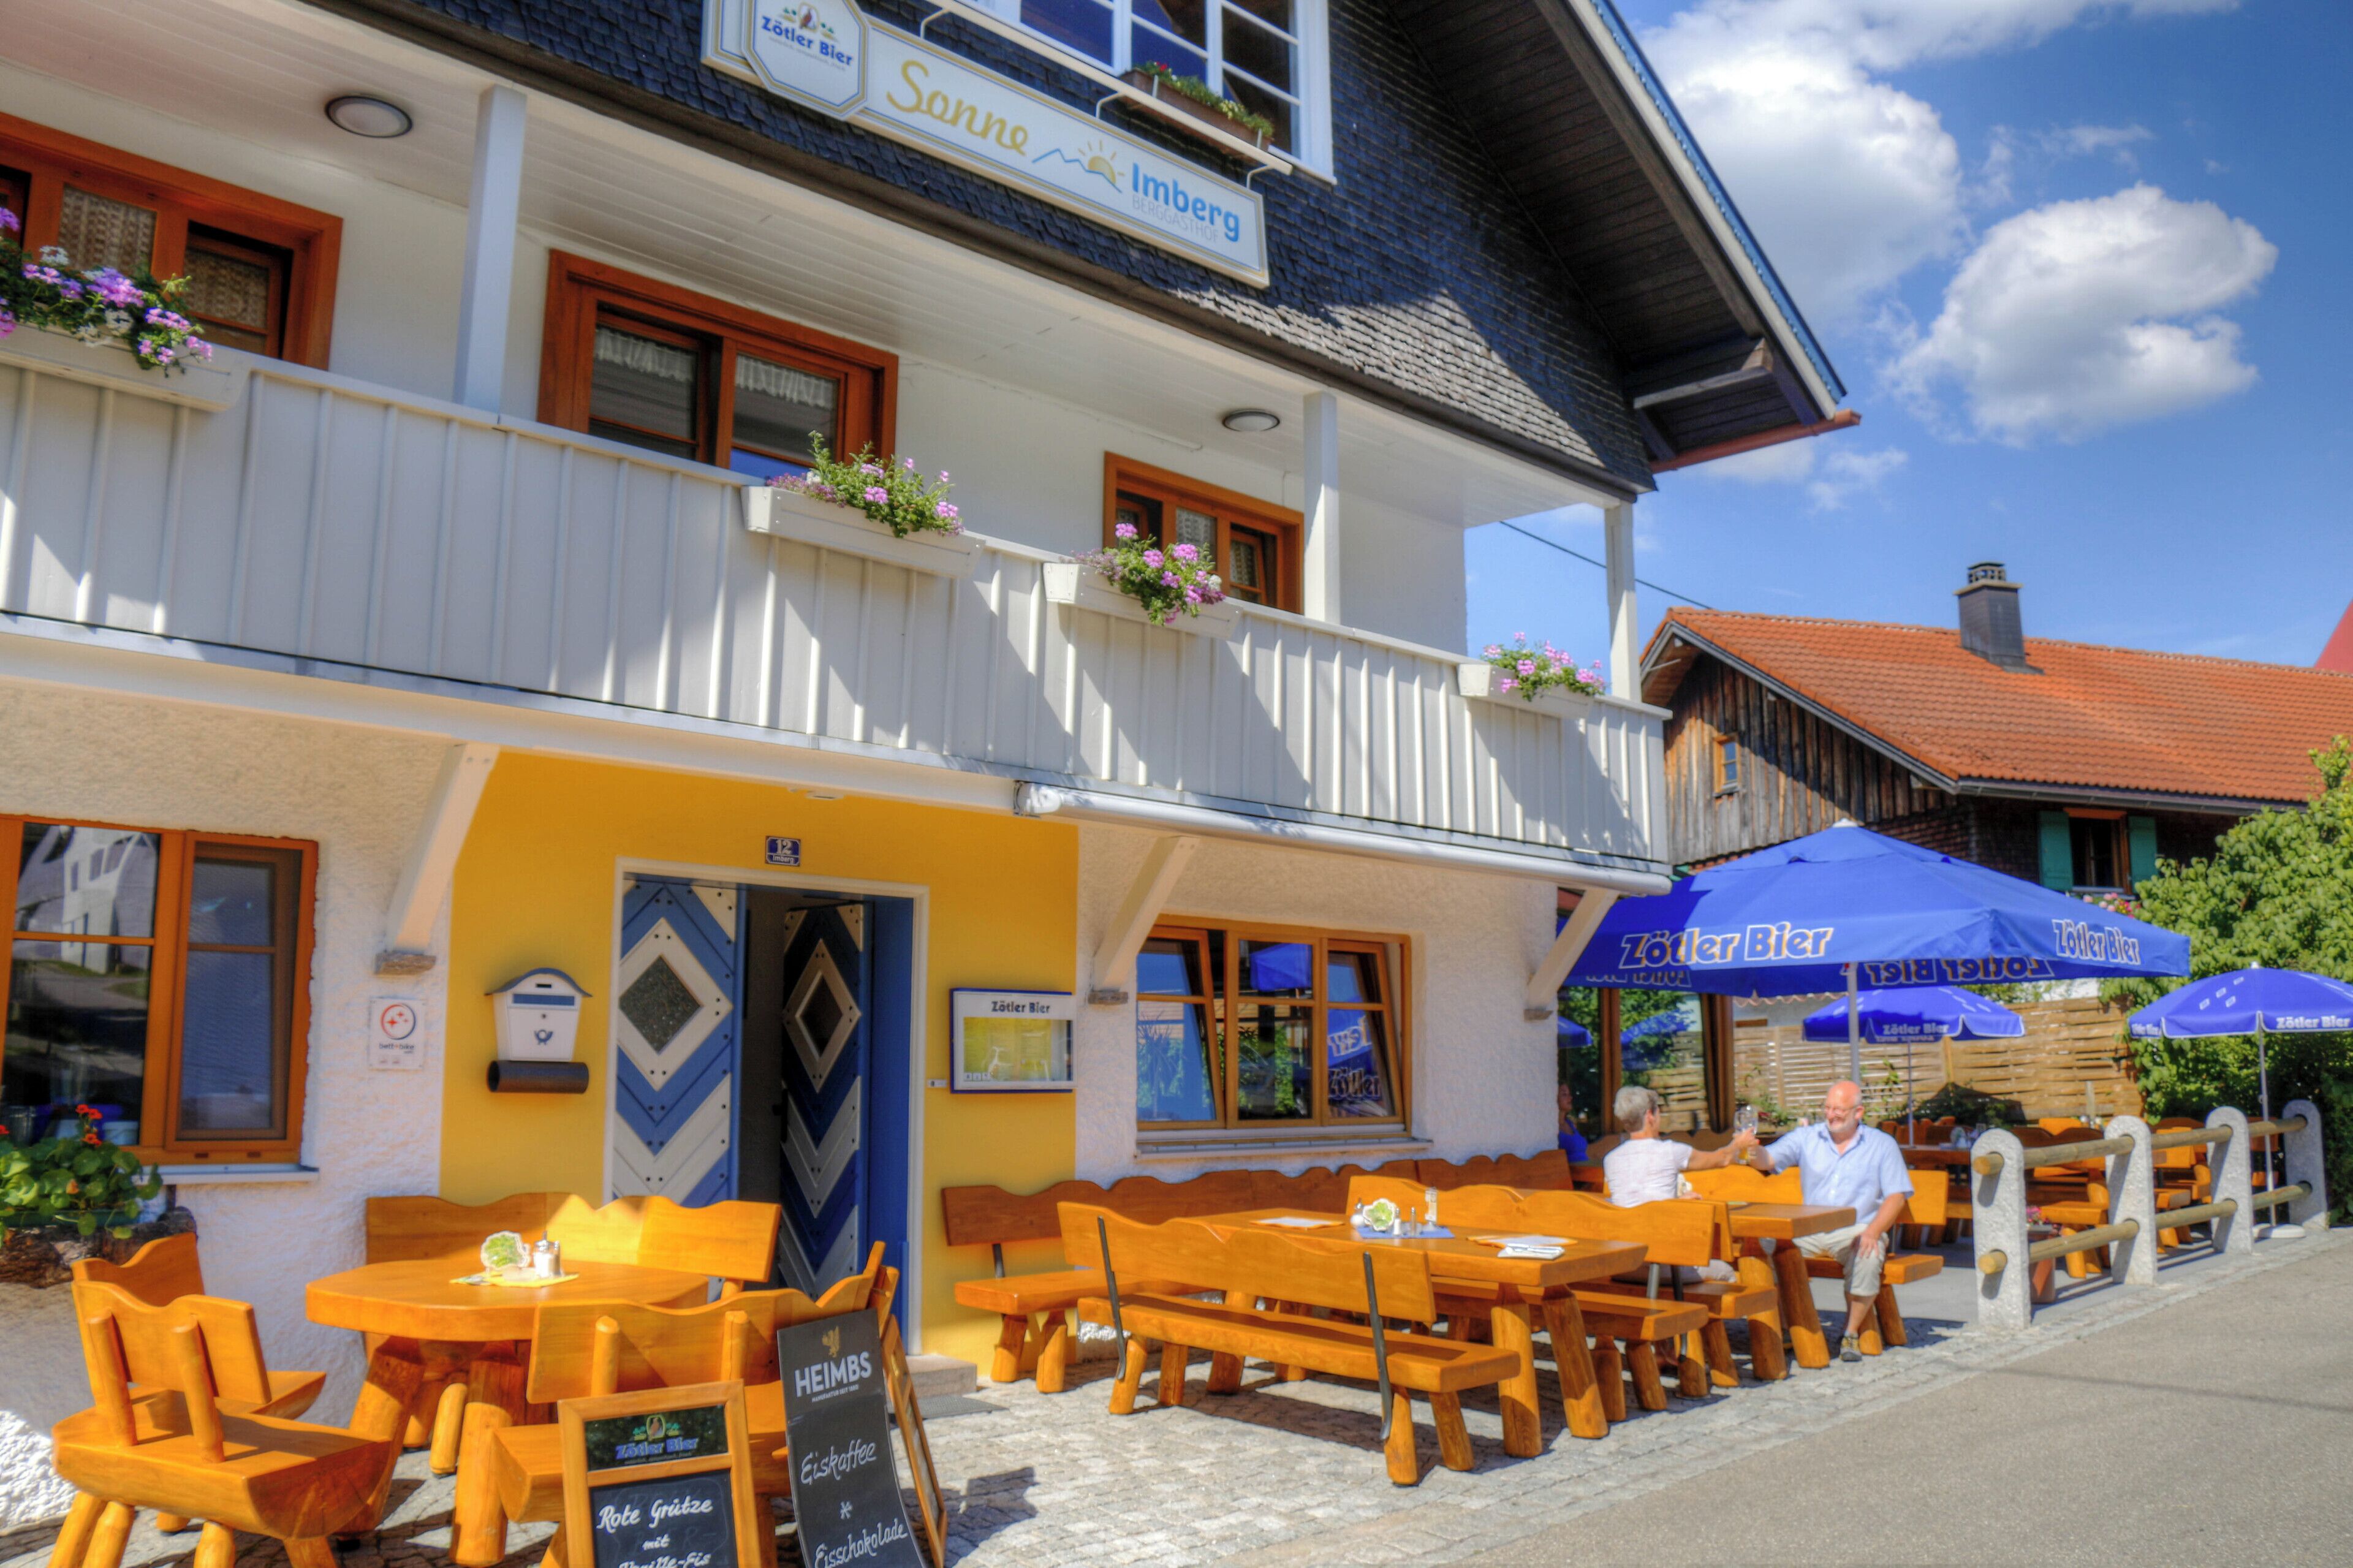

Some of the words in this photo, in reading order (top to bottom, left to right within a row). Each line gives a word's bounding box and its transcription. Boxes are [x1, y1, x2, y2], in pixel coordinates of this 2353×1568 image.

[762, 16, 813, 49] Zötler
[819, 40, 852, 66] Bier
[886, 59, 1028, 156] Sonne
[1132, 162, 1240, 243] Imberg
[1132, 194, 1219, 242] BERGGASTHOF
[775, 839, 792, 855] 12
[1618, 927, 1741, 969] Zötler
[1745, 922, 1834, 960] Bier
[2052, 918, 2106, 961] Zötler
[2104, 926, 2141, 965] Bier
[991, 1000, 1026, 1013] Zötler
[1029, 1002, 1050, 1013] Bier
[1882, 1023, 1921, 1036] Zötler
[1922, 1022, 1949, 1034] Bier
[2276, 1016, 2319, 1029] Zötler
[2321, 1016, 2352, 1029] Bier
[794, 1350, 872, 1398] HEIMBS
[615, 1441, 665, 1460] Zötler
[665, 1436, 700, 1453] Bier
[800, 1439, 877, 1485] Eiskaffee
[596, 1504, 642, 1534] Rote
[648, 1495, 714, 1529] Grütze
[643, 1533, 671, 1551] mit
[814, 1518, 909, 1568] Eisschokolade
